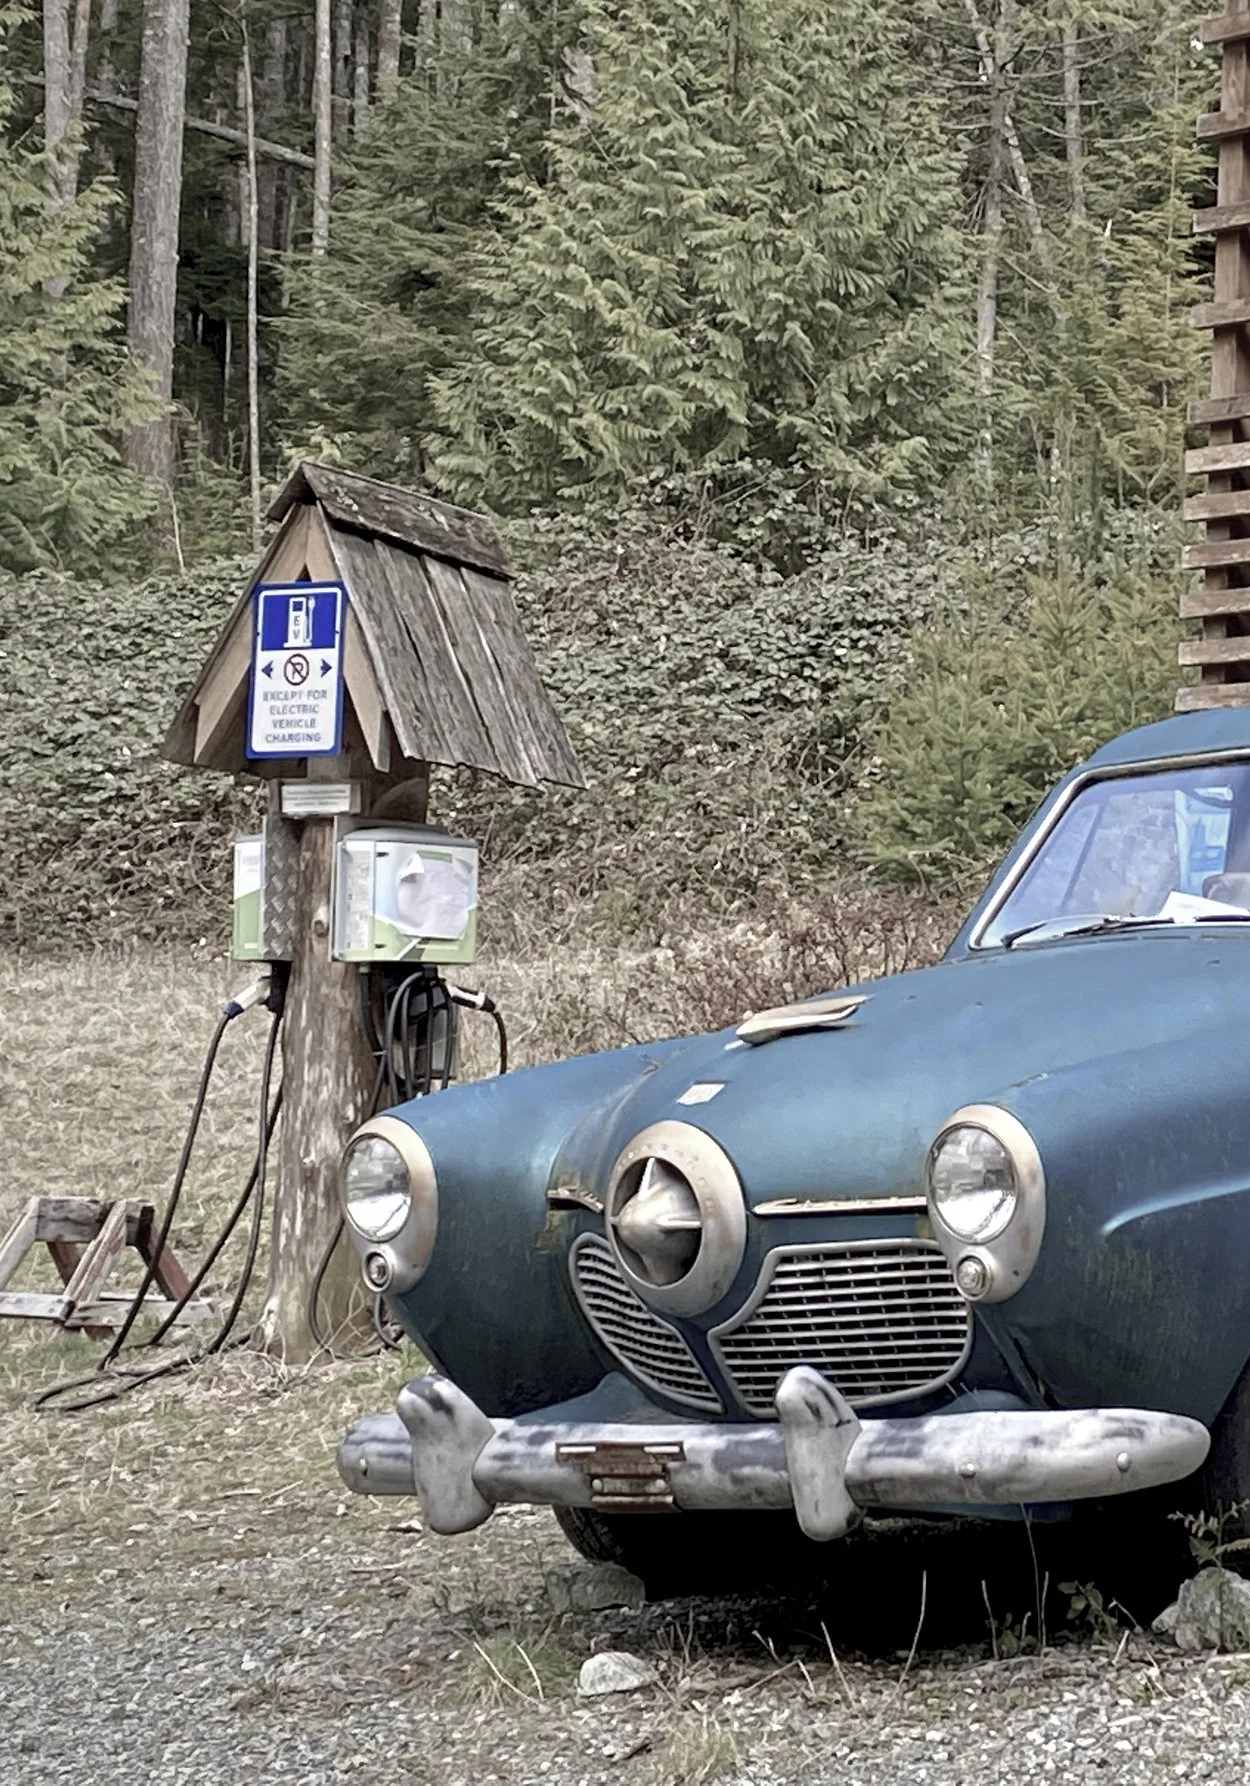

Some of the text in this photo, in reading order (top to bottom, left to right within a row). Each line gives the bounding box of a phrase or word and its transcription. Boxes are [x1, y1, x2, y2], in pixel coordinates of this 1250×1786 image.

[292, 615, 301, 640] EV
[262, 689, 328, 701] EXCEPT FOR
[269, 704, 320, 715] ELECTRIC
[272, 718, 317, 729] VEHICLE
[265, 732, 322, 743] CHARGING
